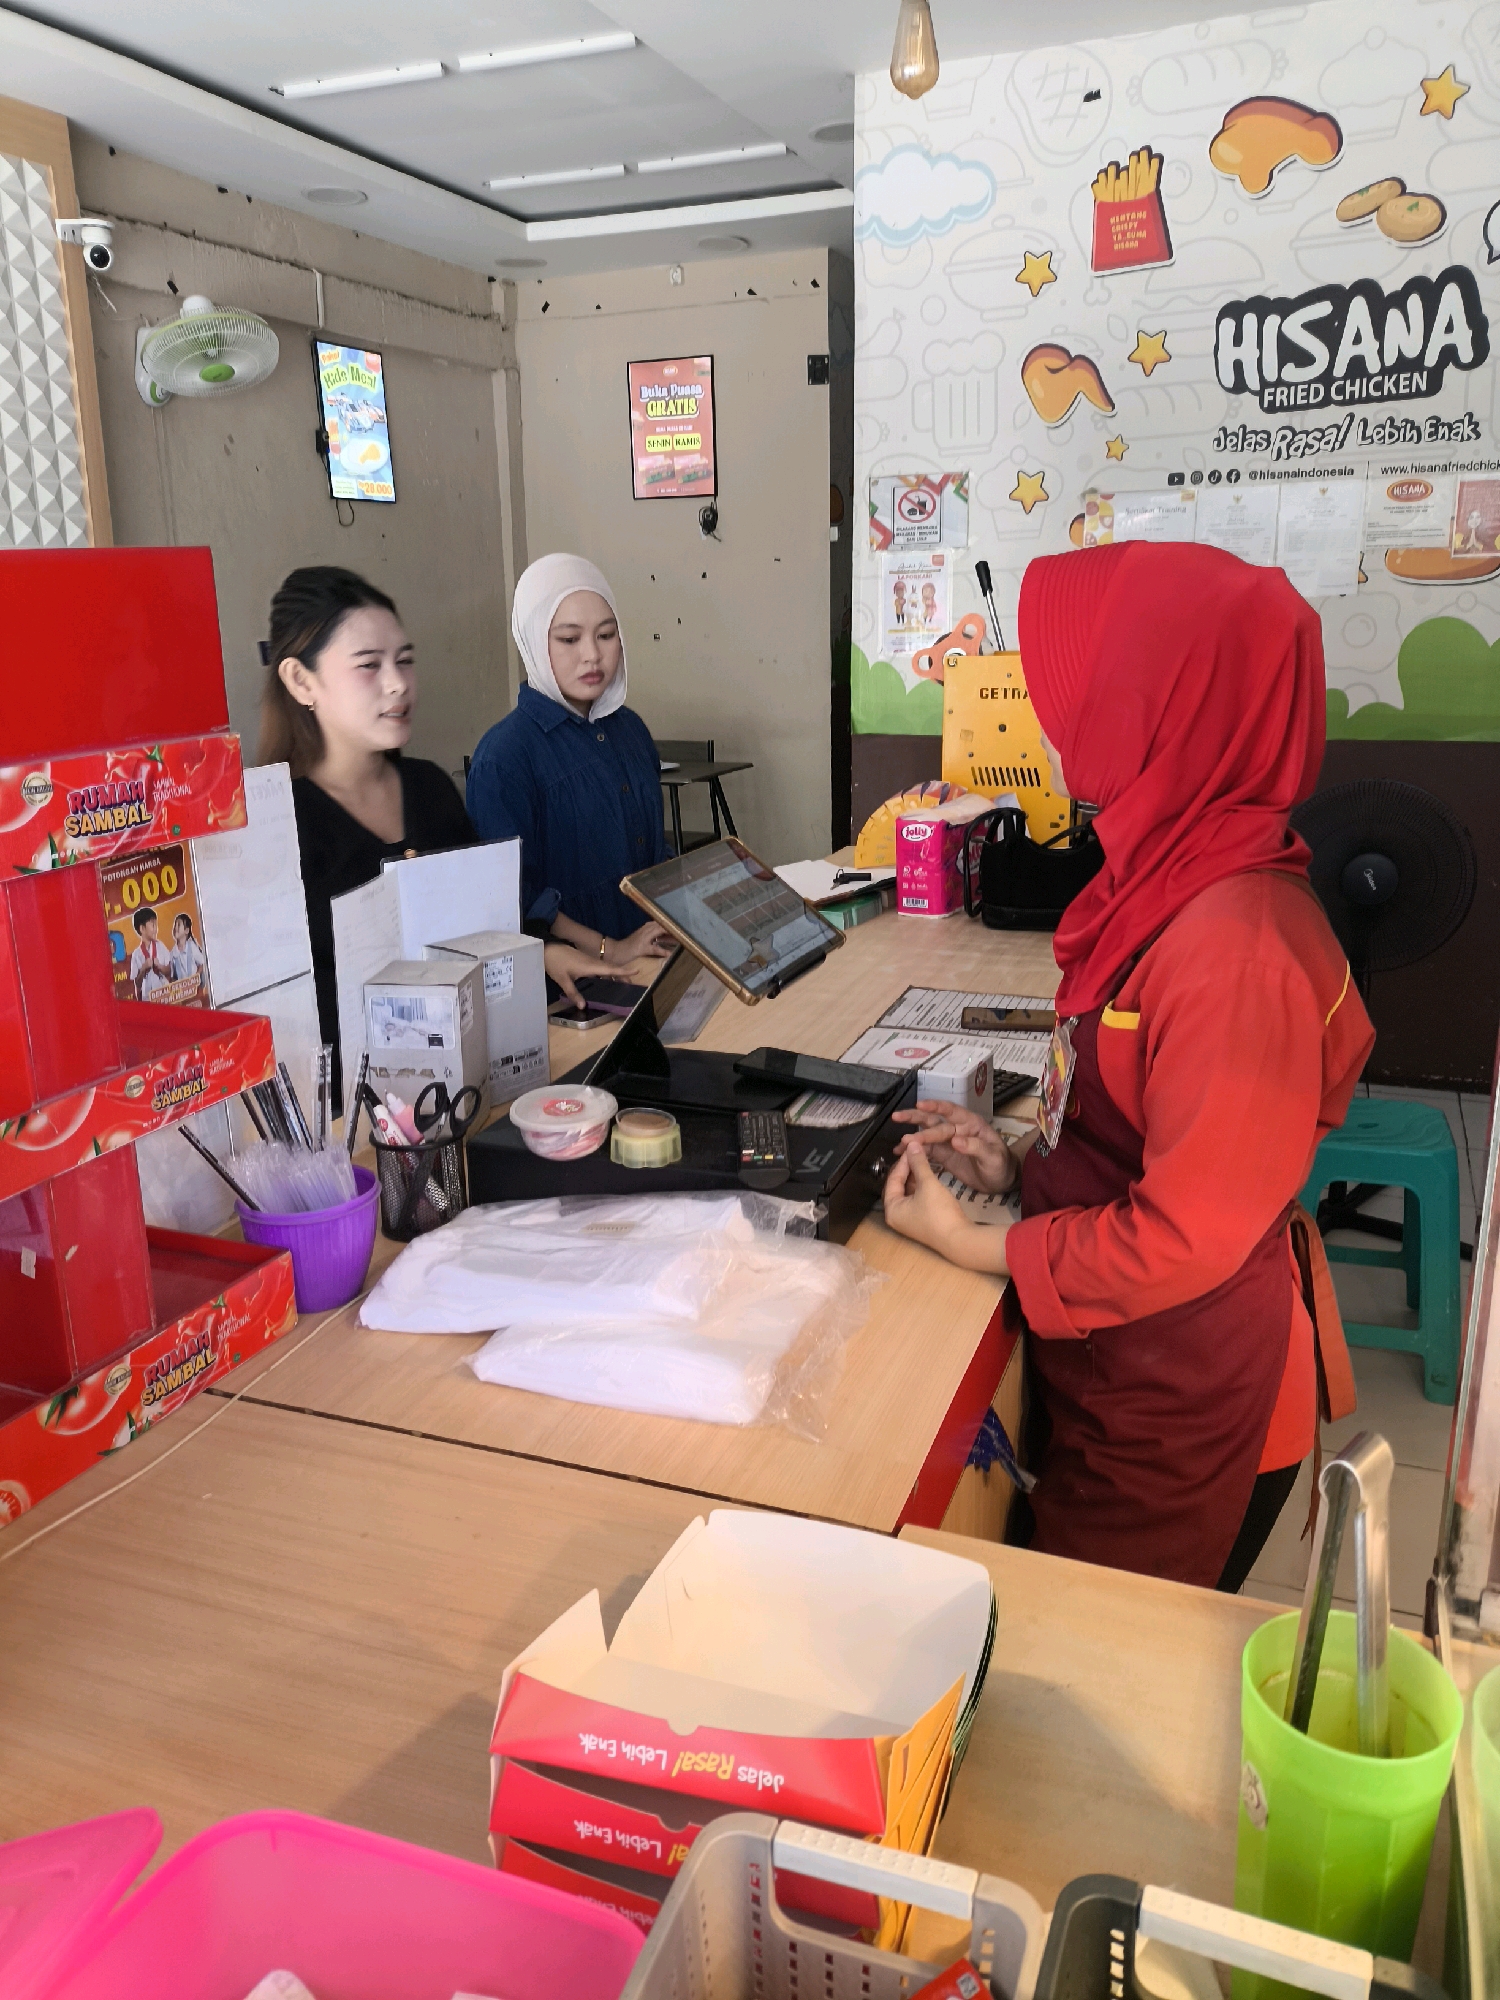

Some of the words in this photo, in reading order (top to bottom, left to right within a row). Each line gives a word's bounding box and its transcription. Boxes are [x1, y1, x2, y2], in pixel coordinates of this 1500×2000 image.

[1217, 281, 1474, 390] HISANA
[323, 367, 348, 390] Kids
[1263, 381, 1325, 409] FRIED
[1330, 373, 1429, 403] CHICKEN
[646, 397, 698, 418] GRATIS
[647, 438, 671, 448] SENIN
[674, 437, 701, 447] KAMIS
[1212, 425, 1270, 454] Jelas
[1271, 413, 1355, 461] Rasa!
[1357, 414, 1422, 446] Lebih
[1424, 412, 1481, 443] Enak
[1248, 466, 1355, 482] @hisanaindonesia
[1393, 483, 1426, 496] HISANA
[69, 781, 146, 814] RUMAH
[65, 803, 153, 838] SAMBAL
[905, 826, 928, 838] jolly
[103, 863, 139, 883] POTONGAN
[139, 857, 161, 872] HARGA
[151, 1078, 209, 1112] SAMBAL
[153, 1065, 204, 1098] RUMAH
[143, 1331, 211, 1386] RUMAH
[141, 1348, 217, 1407] SAMBAL
[578, 1732, 617, 1759] Enak
[621, 1743, 668, 1771] Lebih
[671, 1750, 735, 1781] Rasa!
[737, 1765, 785, 1794] Jelas
[573, 1819, 613, 1845] Enak
[615, 1829, 662, 1859] Lebih
